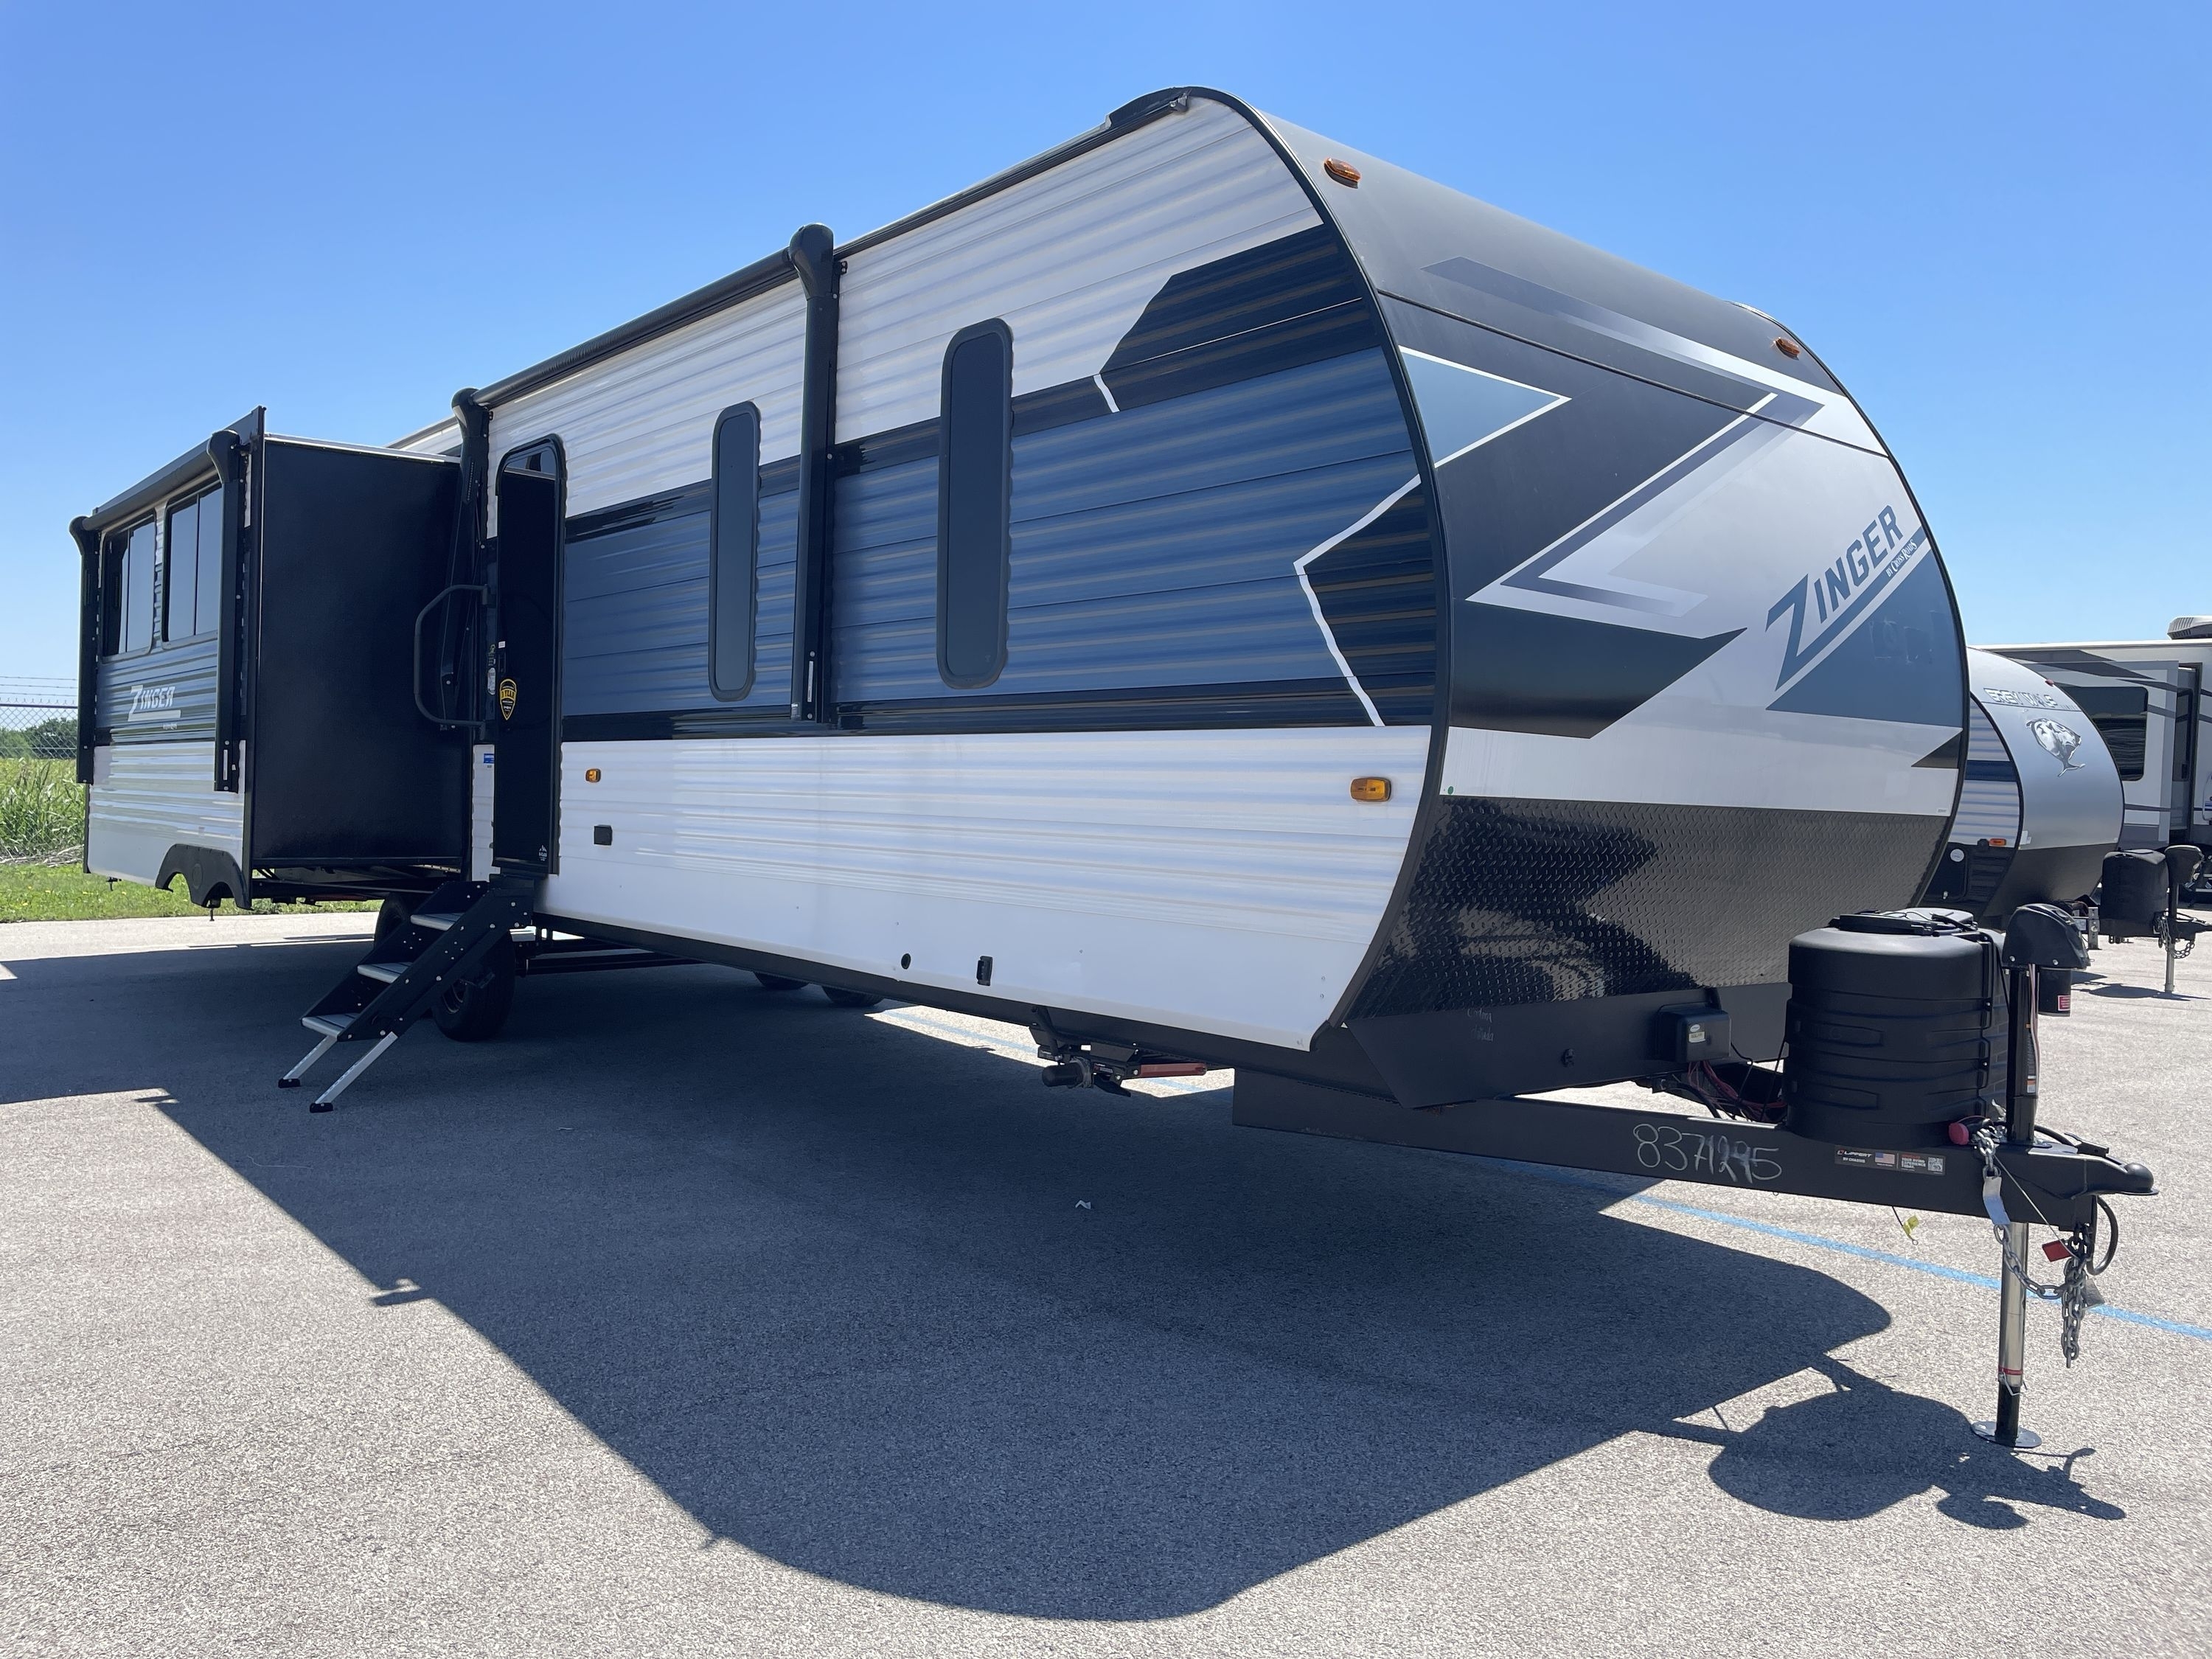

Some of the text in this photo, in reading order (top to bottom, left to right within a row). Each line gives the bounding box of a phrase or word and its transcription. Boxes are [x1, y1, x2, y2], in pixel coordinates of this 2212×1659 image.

[1885, 566, 1893, 577] BY
[1765, 505, 1905, 692] ZINGER
[128, 684, 180, 722] ZINGER
